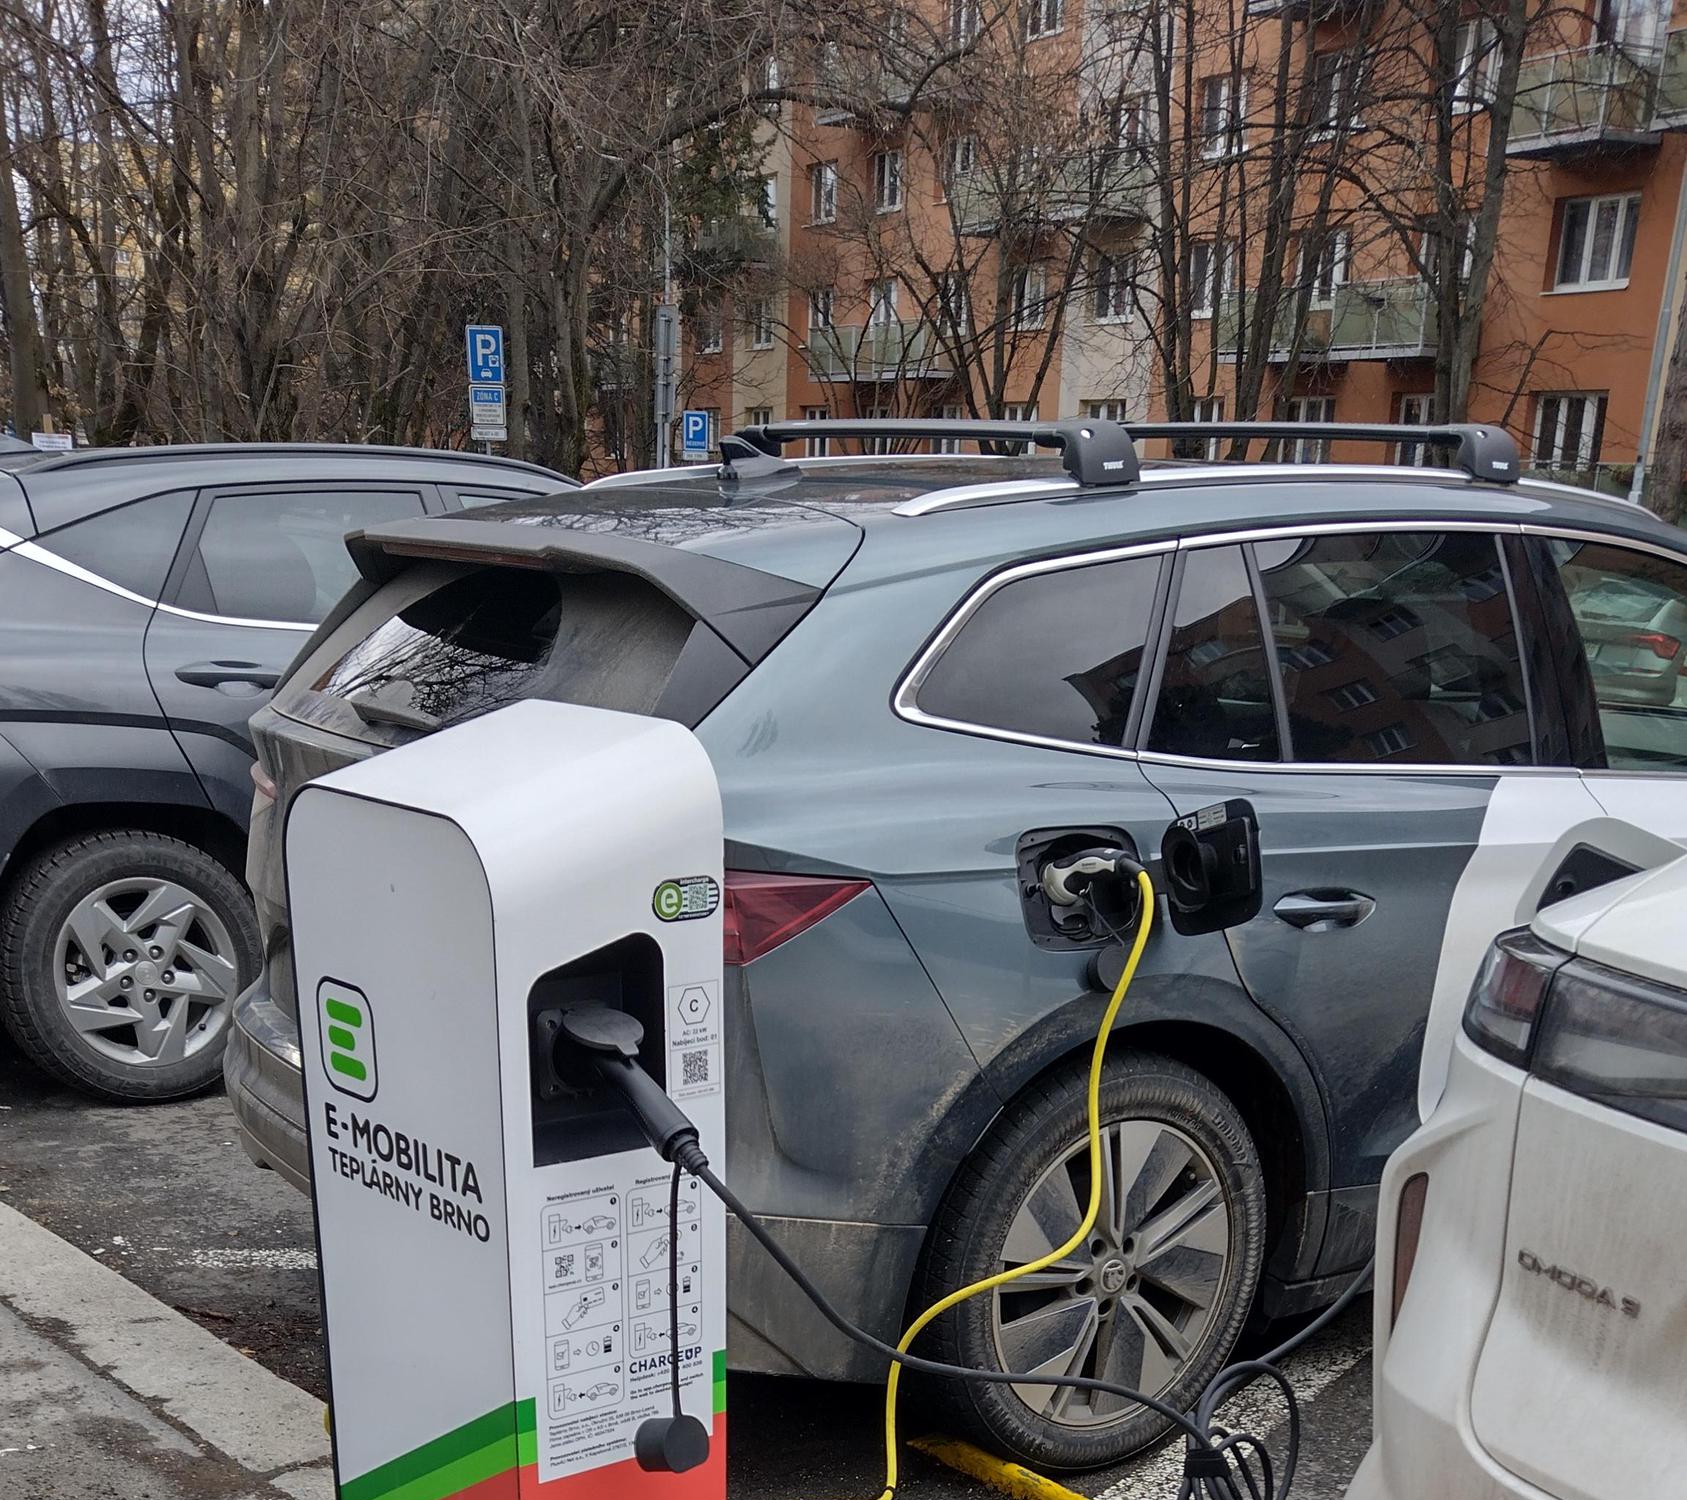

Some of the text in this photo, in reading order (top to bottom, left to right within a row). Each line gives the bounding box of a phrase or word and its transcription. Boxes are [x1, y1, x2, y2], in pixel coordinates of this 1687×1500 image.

[475, 333, 496, 366] P
[688, 416, 703, 439] P
[689, 998, 699, 1013] C
[325, 1101, 483, 1204] E-MOBILITA
[328, 1146, 490, 1242] TEPLÁRNY BRNO
[1518, 1249, 1616, 1311] OMODA
